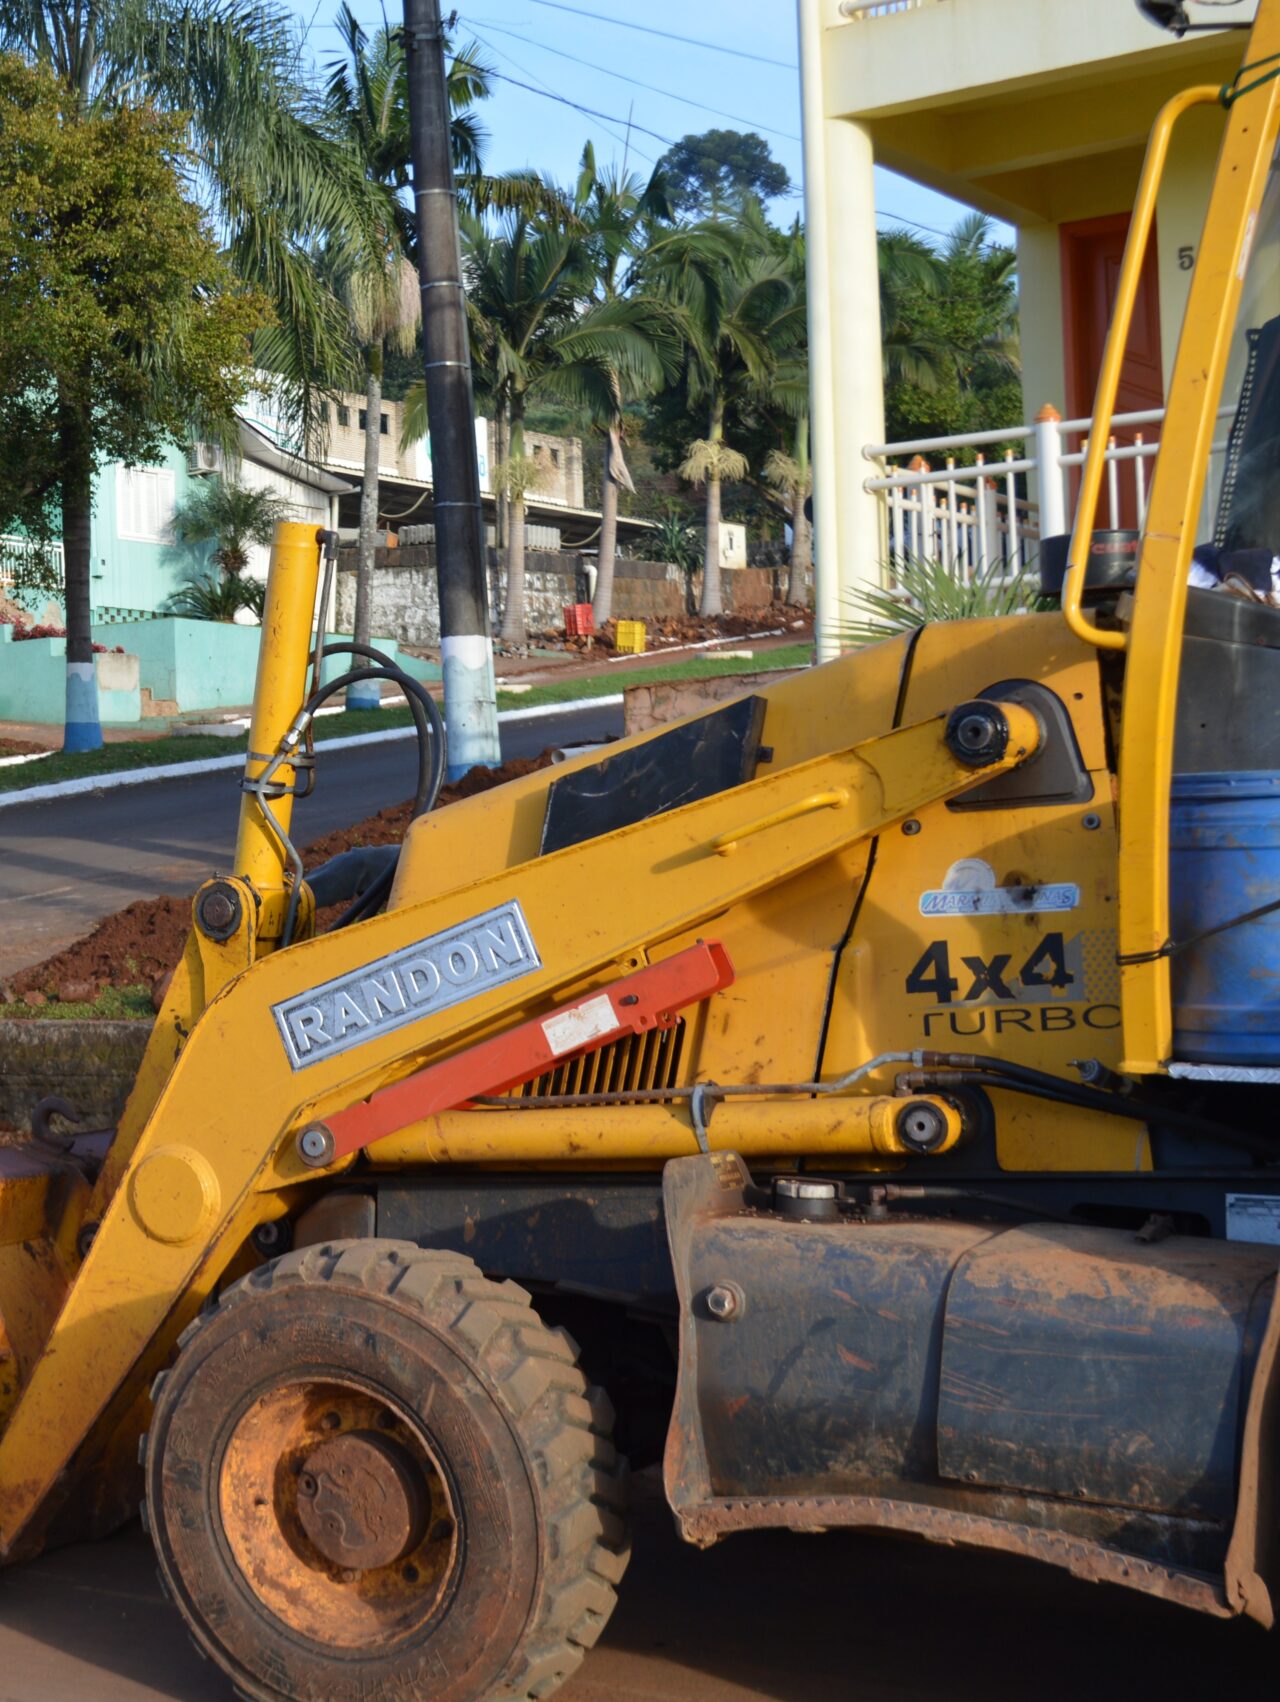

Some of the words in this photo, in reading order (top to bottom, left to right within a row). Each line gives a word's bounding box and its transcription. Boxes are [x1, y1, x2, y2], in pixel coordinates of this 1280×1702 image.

[287, 919, 524, 1052] RANDON
[905, 932, 1075, 1004] 4x4
[922, 1003, 1122, 1038] TURBO
